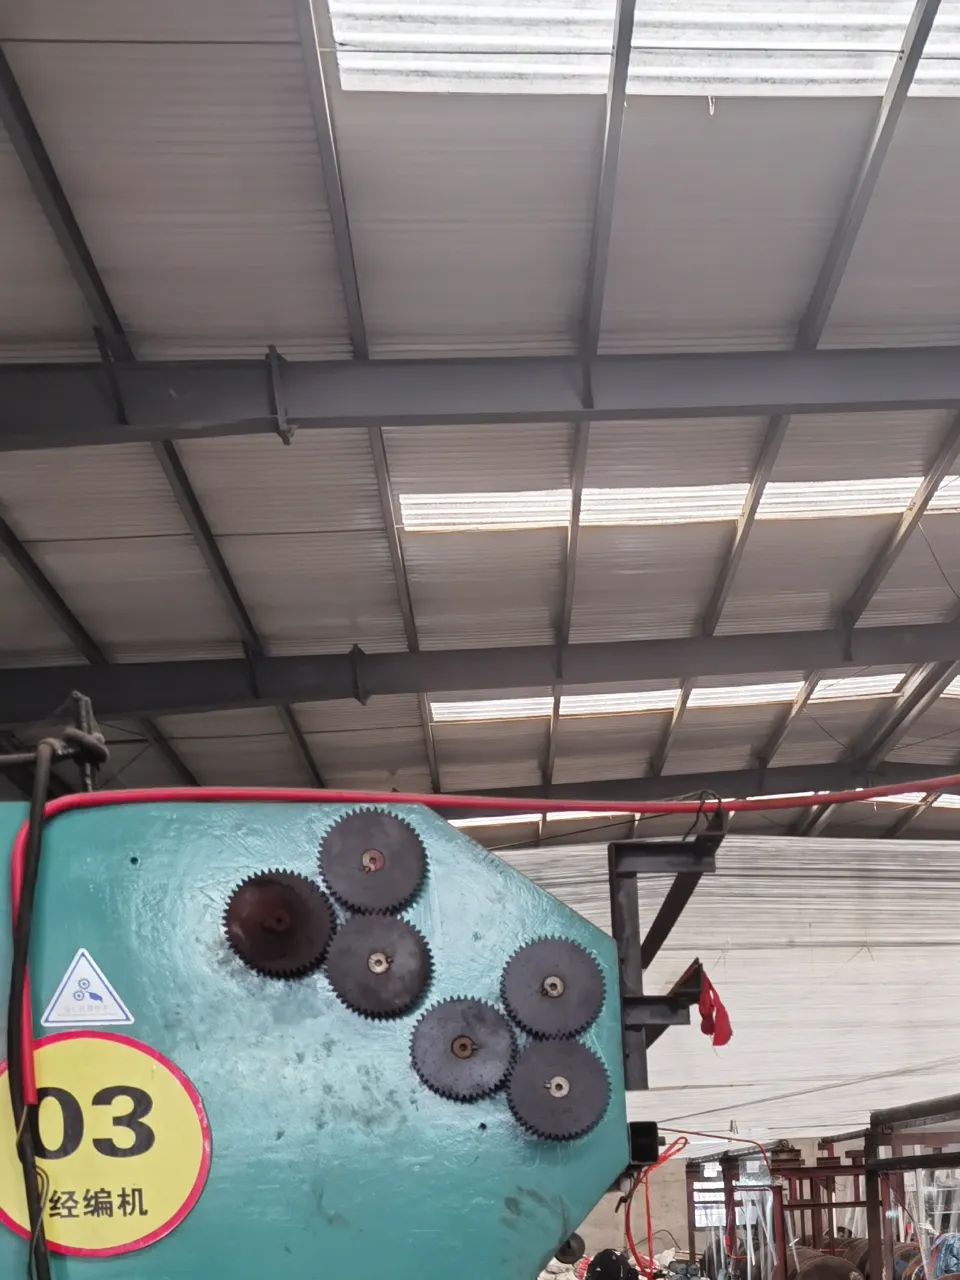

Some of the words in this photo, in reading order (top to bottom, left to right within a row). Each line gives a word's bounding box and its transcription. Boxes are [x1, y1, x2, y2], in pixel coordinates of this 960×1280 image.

[30, 1085, 155, 1160] 03
[48, 1187, 148, 1218] 经编机
